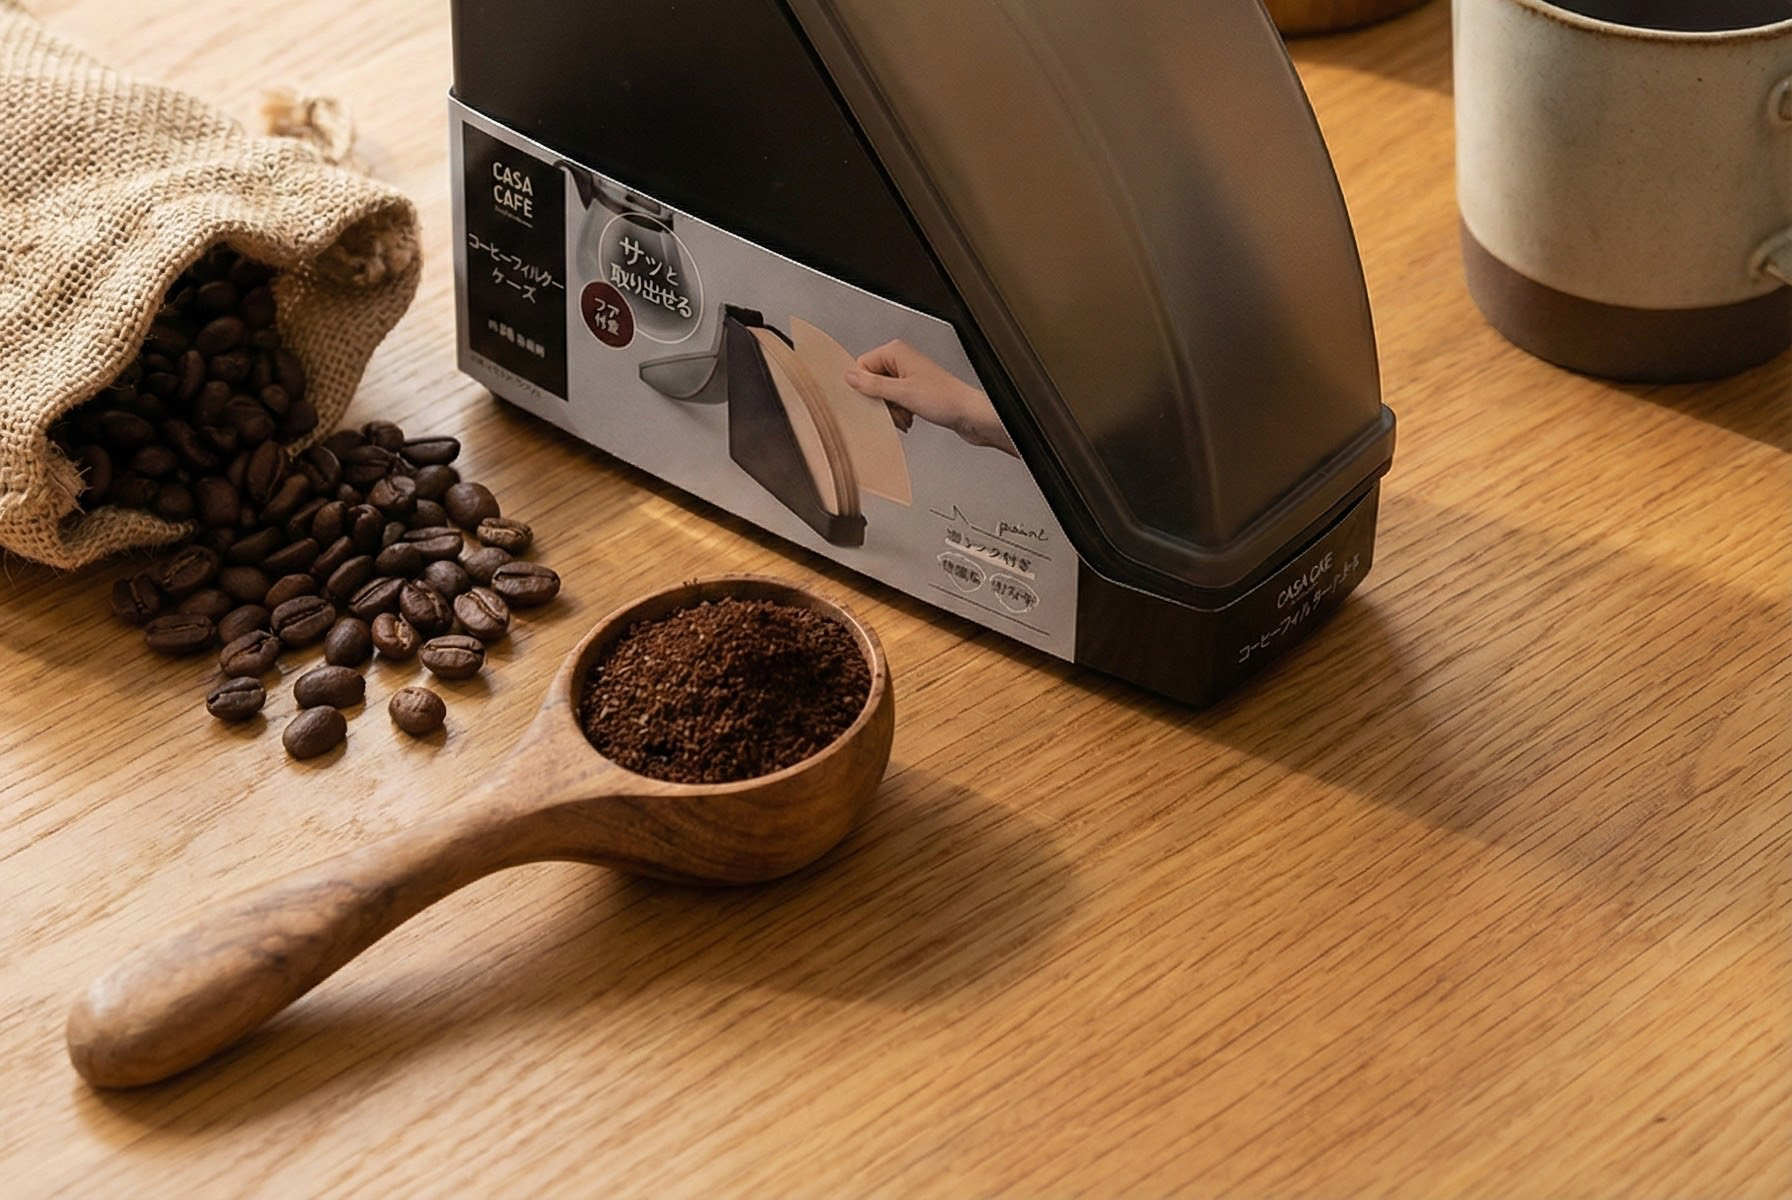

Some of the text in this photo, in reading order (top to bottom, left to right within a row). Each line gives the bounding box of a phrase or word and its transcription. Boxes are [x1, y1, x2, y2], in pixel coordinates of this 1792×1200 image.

[492, 161, 534, 197] CASA
[493, 184, 534, 219] CAFE
[619, 236, 679, 286] サッと
[610, 263, 692, 319] 取り出せる
[999, 520, 1049, 542] point
